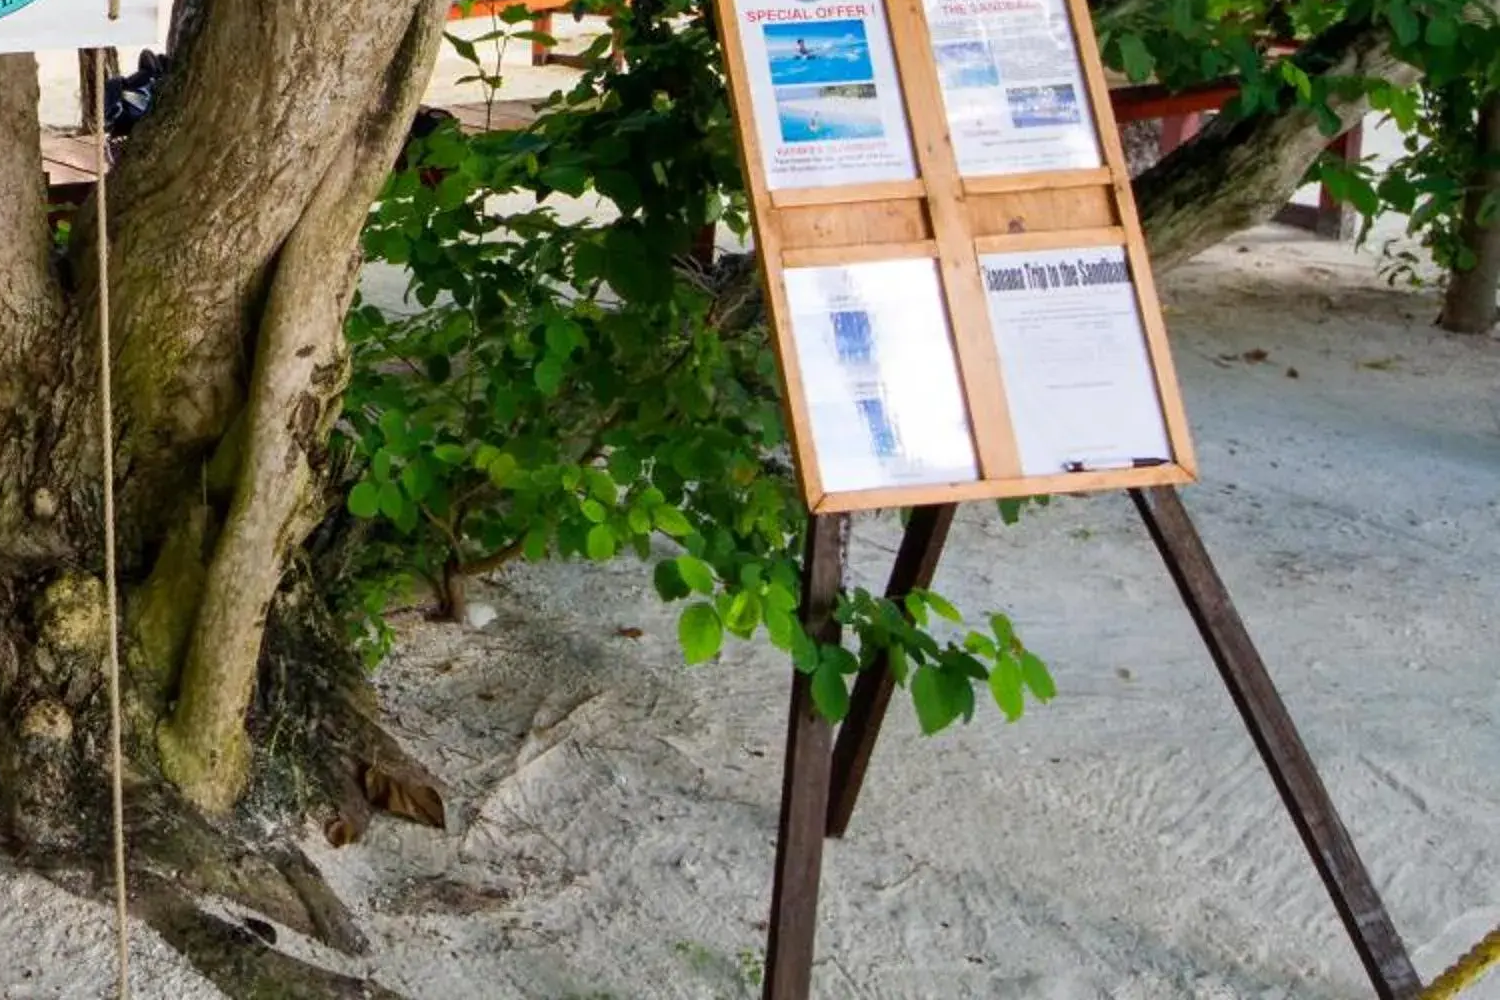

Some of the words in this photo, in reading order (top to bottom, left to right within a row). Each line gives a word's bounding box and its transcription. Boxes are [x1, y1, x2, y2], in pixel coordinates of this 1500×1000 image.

[745, 7, 812, 23] SPECIAL
[815, 4, 868, 19] OFFER
[1023, 261, 1048, 291] Trip
[1046, 263, 1061, 288] to
[1059, 258, 1078, 287] the
[1077, 258, 1127, 287] Sandban
